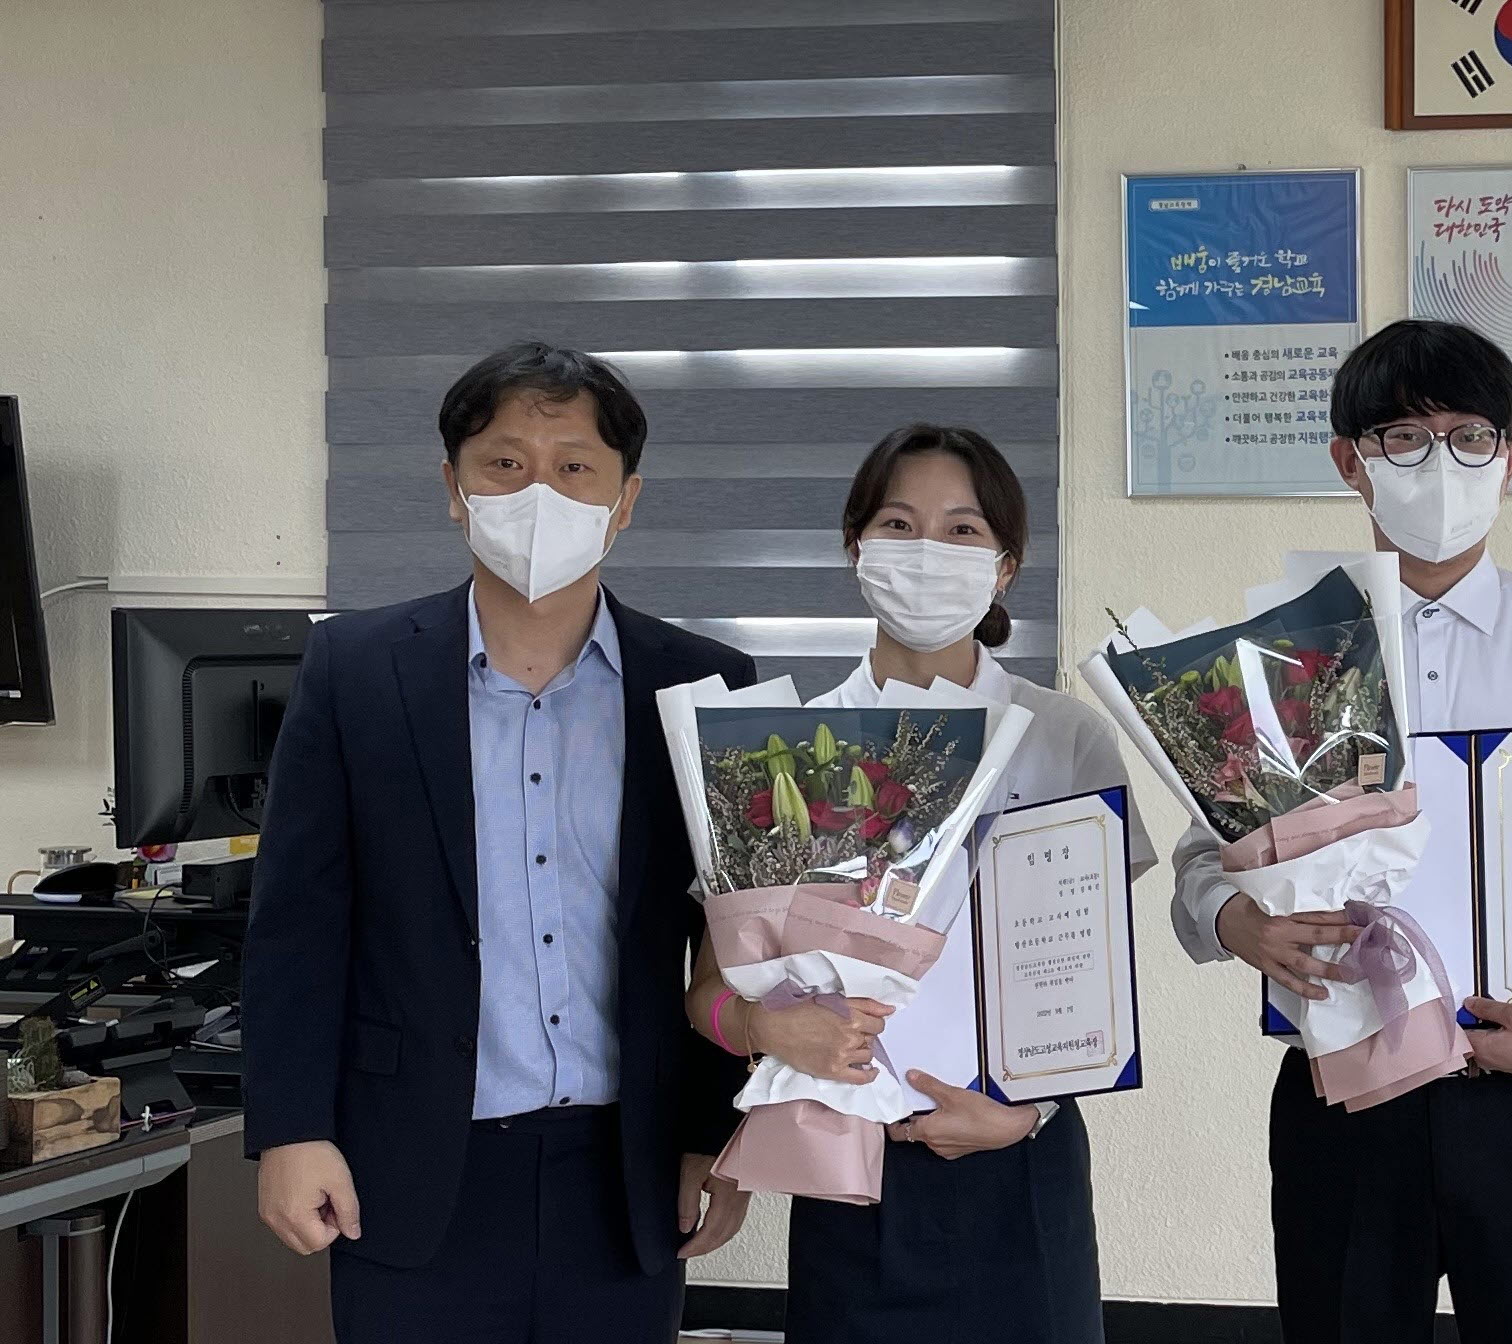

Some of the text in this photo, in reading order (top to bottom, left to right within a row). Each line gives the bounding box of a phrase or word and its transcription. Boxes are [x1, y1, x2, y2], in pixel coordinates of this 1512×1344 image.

[1434, 196, 1471, 218] 다시
[1434, 218, 1506, 244] 대한민국
[1171, 246, 1308, 273] 배움이 즐거운 학교
[1156, 272, 1325, 301] 함께 가꾸는 경남교육
[1282, 347, 1314, 360] 새로운
[1317, 346, 1338, 359] 교육
[1231, 370, 1257, 382] 소통과
[1260, 370, 1285, 382] 공감의
[1232, 389, 1330, 403] 안전하고 건강한 교육환
[1233, 413, 1260, 424] 더불어
[1295, 410, 1328, 423] 교육복
[1270, 433, 1296, 444] 공정한
